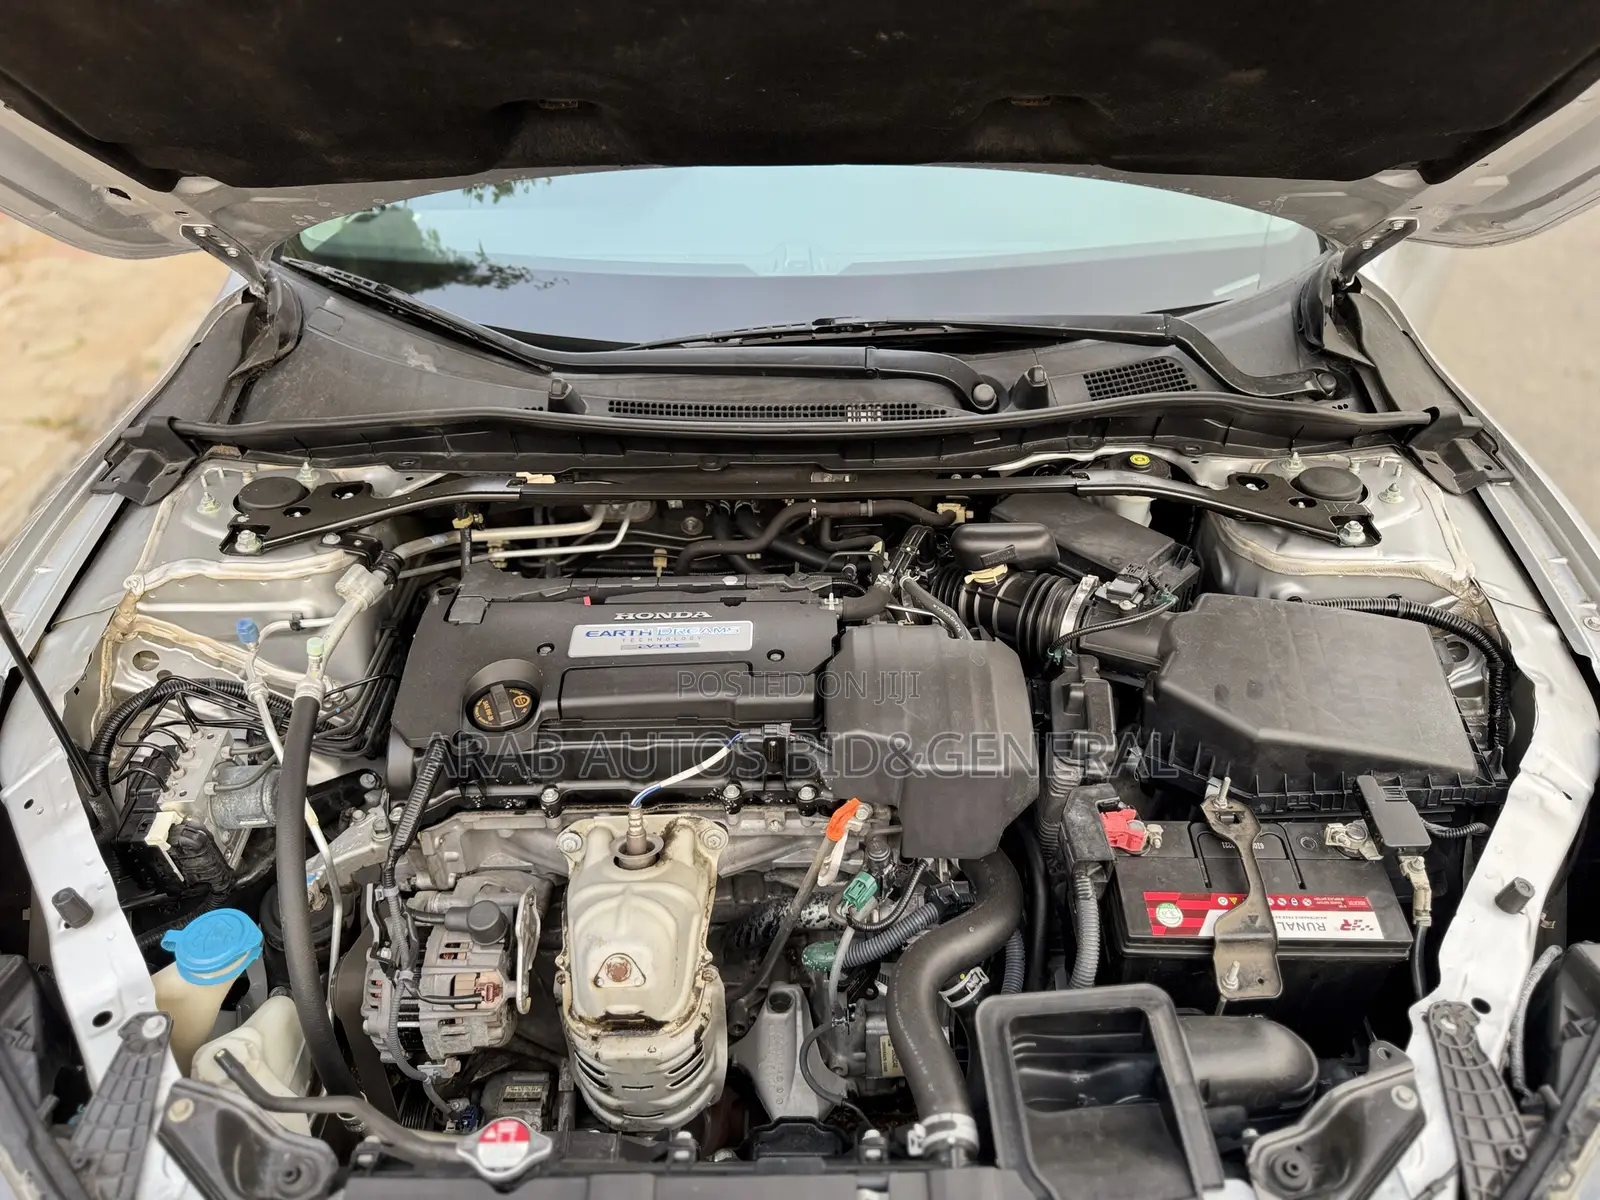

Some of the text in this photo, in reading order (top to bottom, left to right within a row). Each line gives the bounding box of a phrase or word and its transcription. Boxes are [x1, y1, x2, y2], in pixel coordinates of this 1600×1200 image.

[614, 611, 712, 620] HONDA
[585, 626, 741, 638] EARTH DREAMS
[1277, 921, 1327, 932] RUNAL
